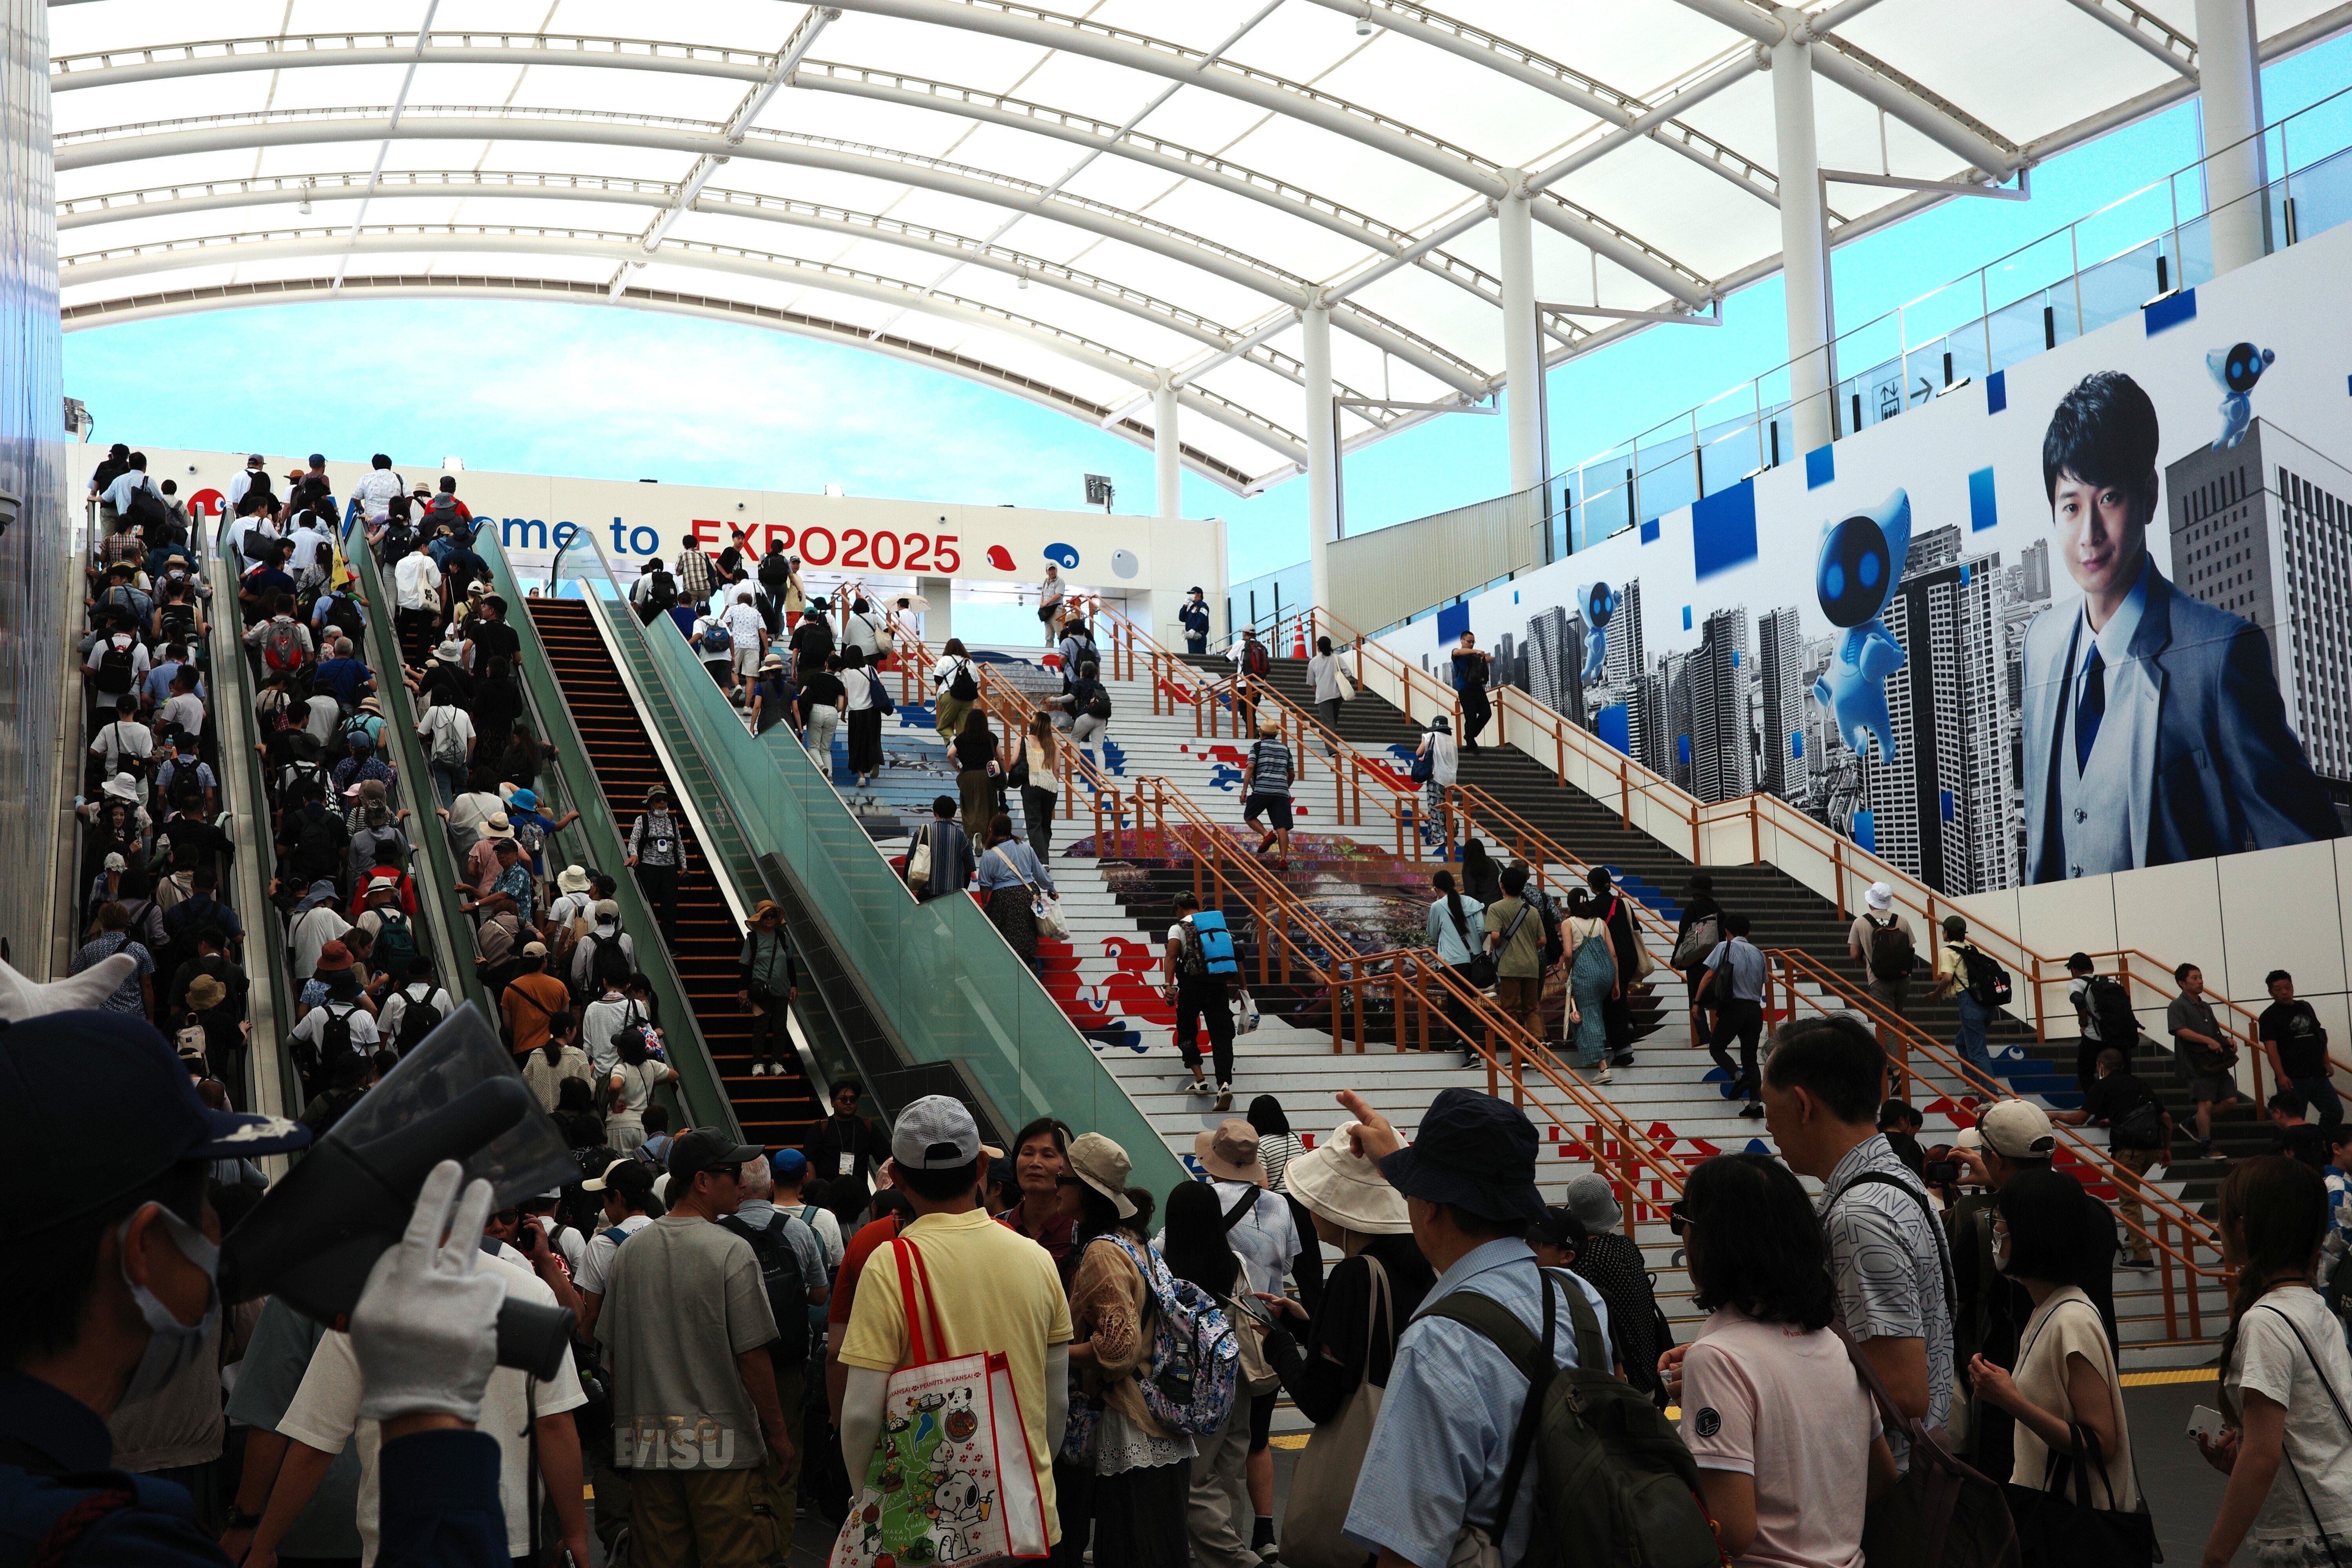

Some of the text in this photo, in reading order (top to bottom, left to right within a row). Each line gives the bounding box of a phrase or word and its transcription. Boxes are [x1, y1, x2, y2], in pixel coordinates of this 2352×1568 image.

[609, 517, 659, 555] to
[692, 519, 960, 573] EXPO2025
[892, 1388, 911, 1396] KANSAI
[920, 1379, 943, 1389] PEANUTS
[952, 1374, 973, 1382] KANSAI
[616, 1427, 734, 1469] EVISU
[895, 1435, 911, 1460] KYOTO
[922, 1438, 939, 1447] SHIGA
[869, 1459, 886, 1468] YOGO
[887, 1490, 905, 1508] OSAKA
[911, 1521, 927, 1529] NARA
